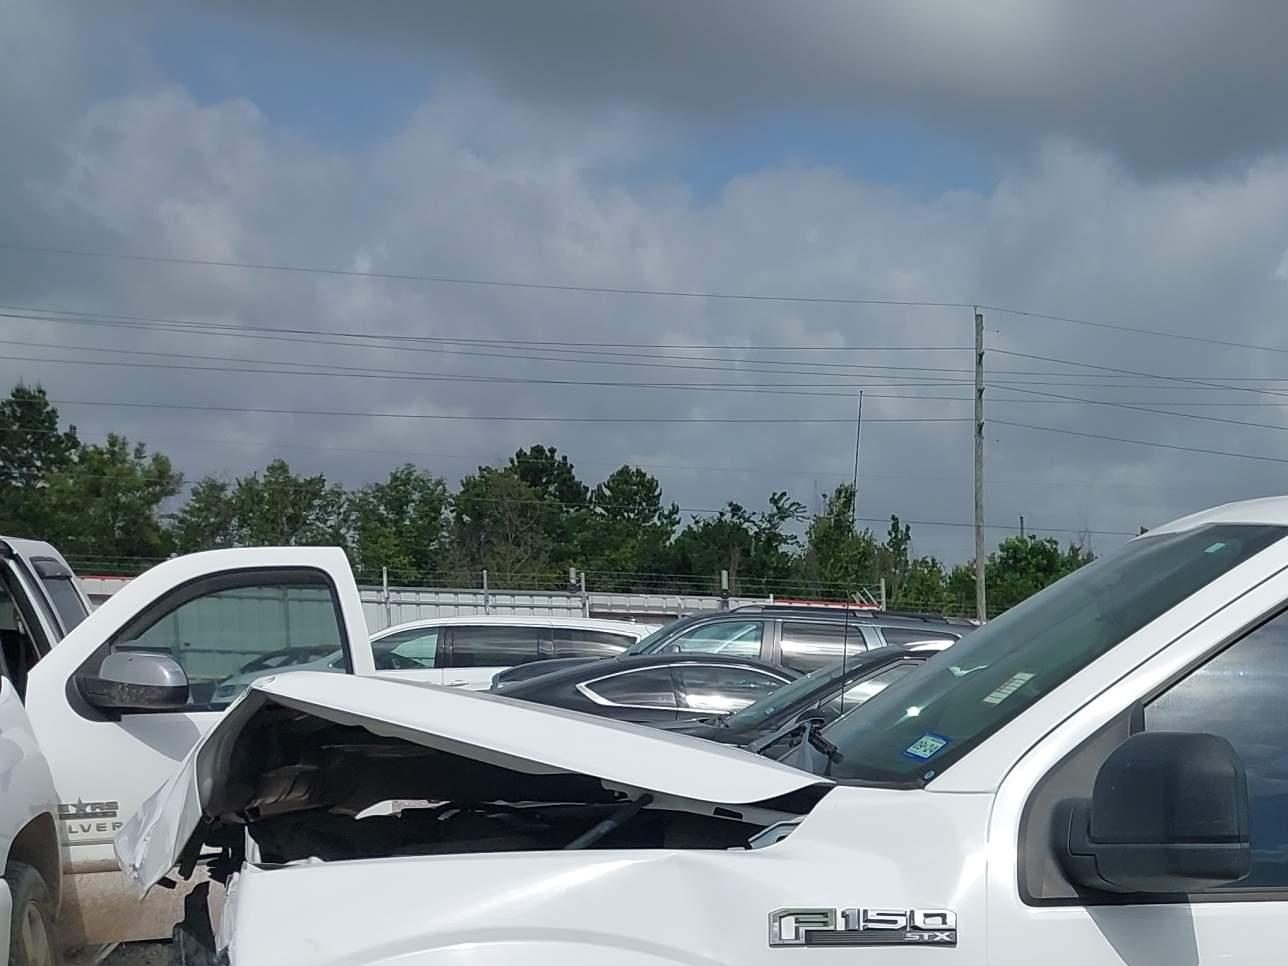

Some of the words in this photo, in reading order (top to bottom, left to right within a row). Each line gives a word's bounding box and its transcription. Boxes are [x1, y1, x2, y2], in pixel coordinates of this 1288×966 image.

[58, 797, 119, 812] EXAS
[67, 821, 124, 834] LVER
[904, 931, 951, 941] STX
